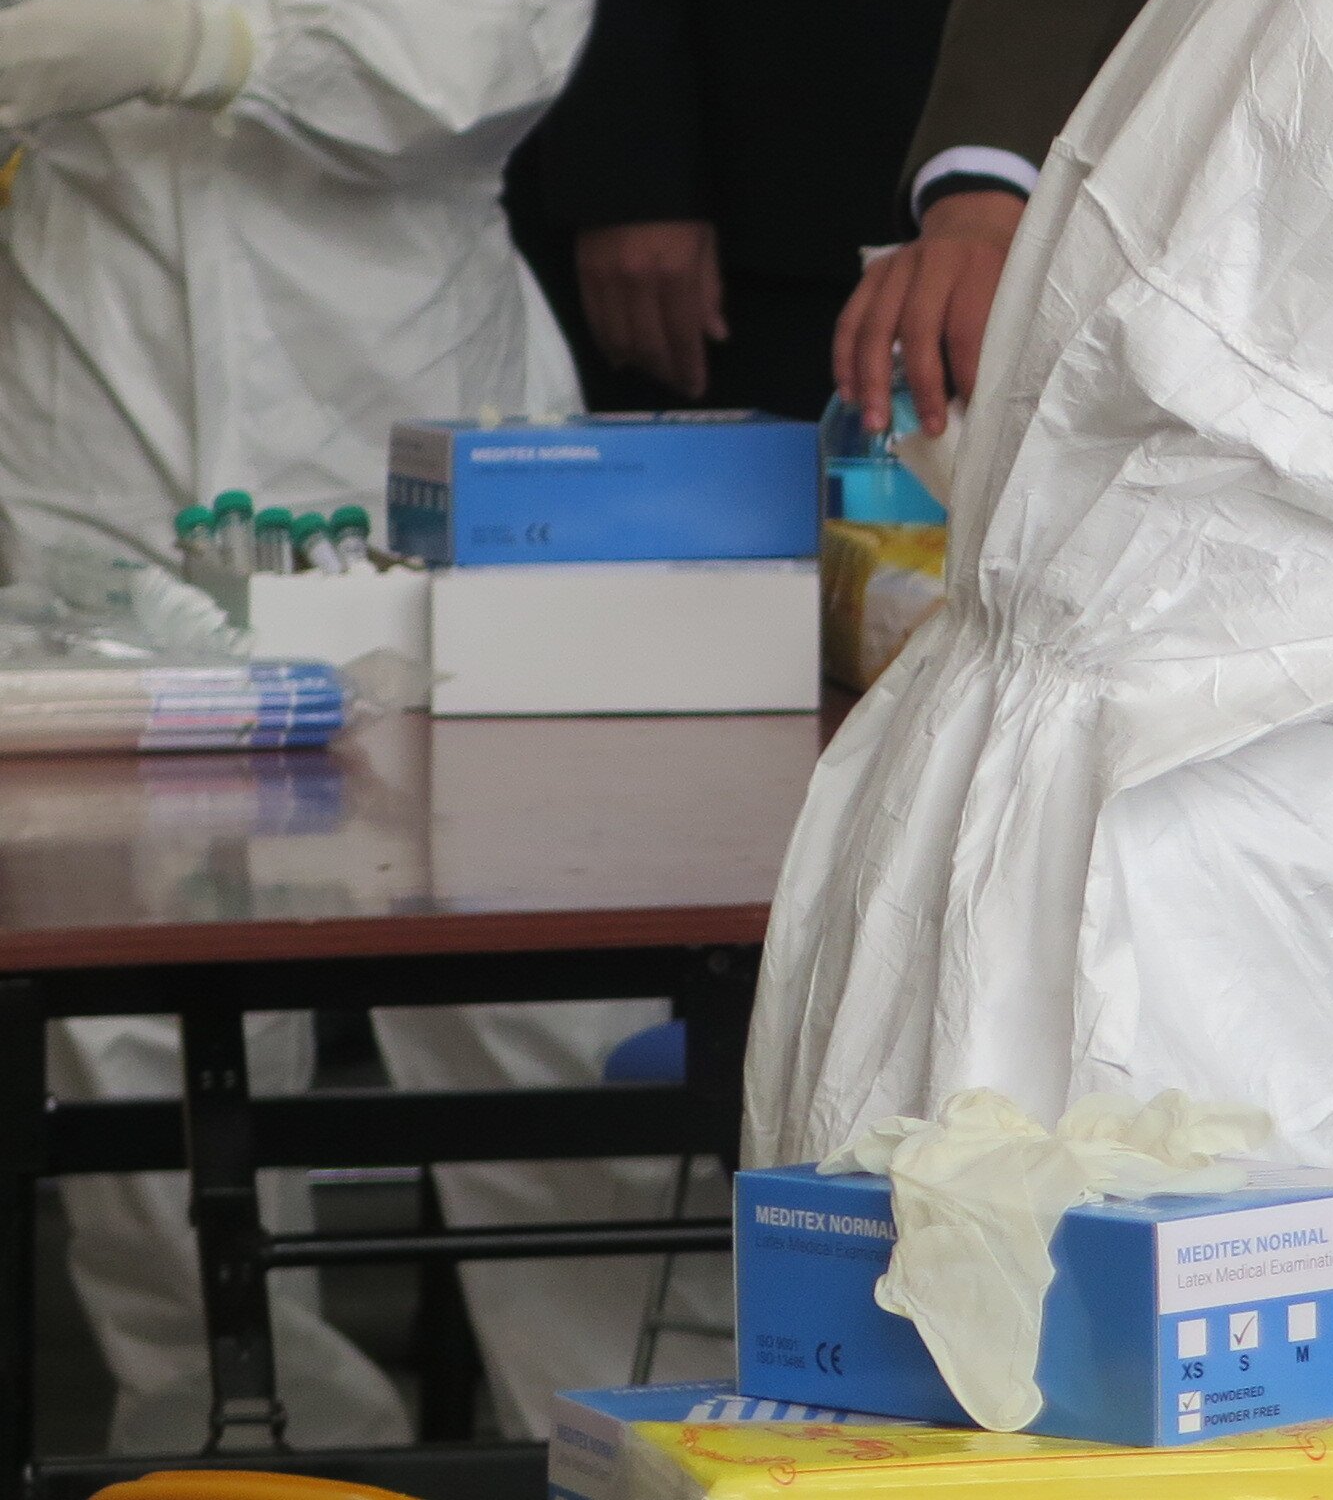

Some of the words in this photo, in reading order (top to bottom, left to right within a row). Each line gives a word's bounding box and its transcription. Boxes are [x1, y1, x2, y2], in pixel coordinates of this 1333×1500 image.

[755, 1204, 826, 1233] MEDITEX
[829, 1213, 898, 1241] NORMAL
[1176, 1237, 1253, 1265] MEDITEX
[1256, 1227, 1329, 1254] NORMAL
[1177, 1271, 1213, 1289] Latex
[1216, 1261, 1267, 1283] Medical
[1181, 1361, 1204, 1382] XS
[1239, 1354, 1251, 1373] S
[1296, 1345, 1310, 1364] M
[1204, 1384, 1265, 1406] POWDERED
[1204, 1409, 1251, 1427] POWDER
[1253, 1403, 1281, 1420] FREE
